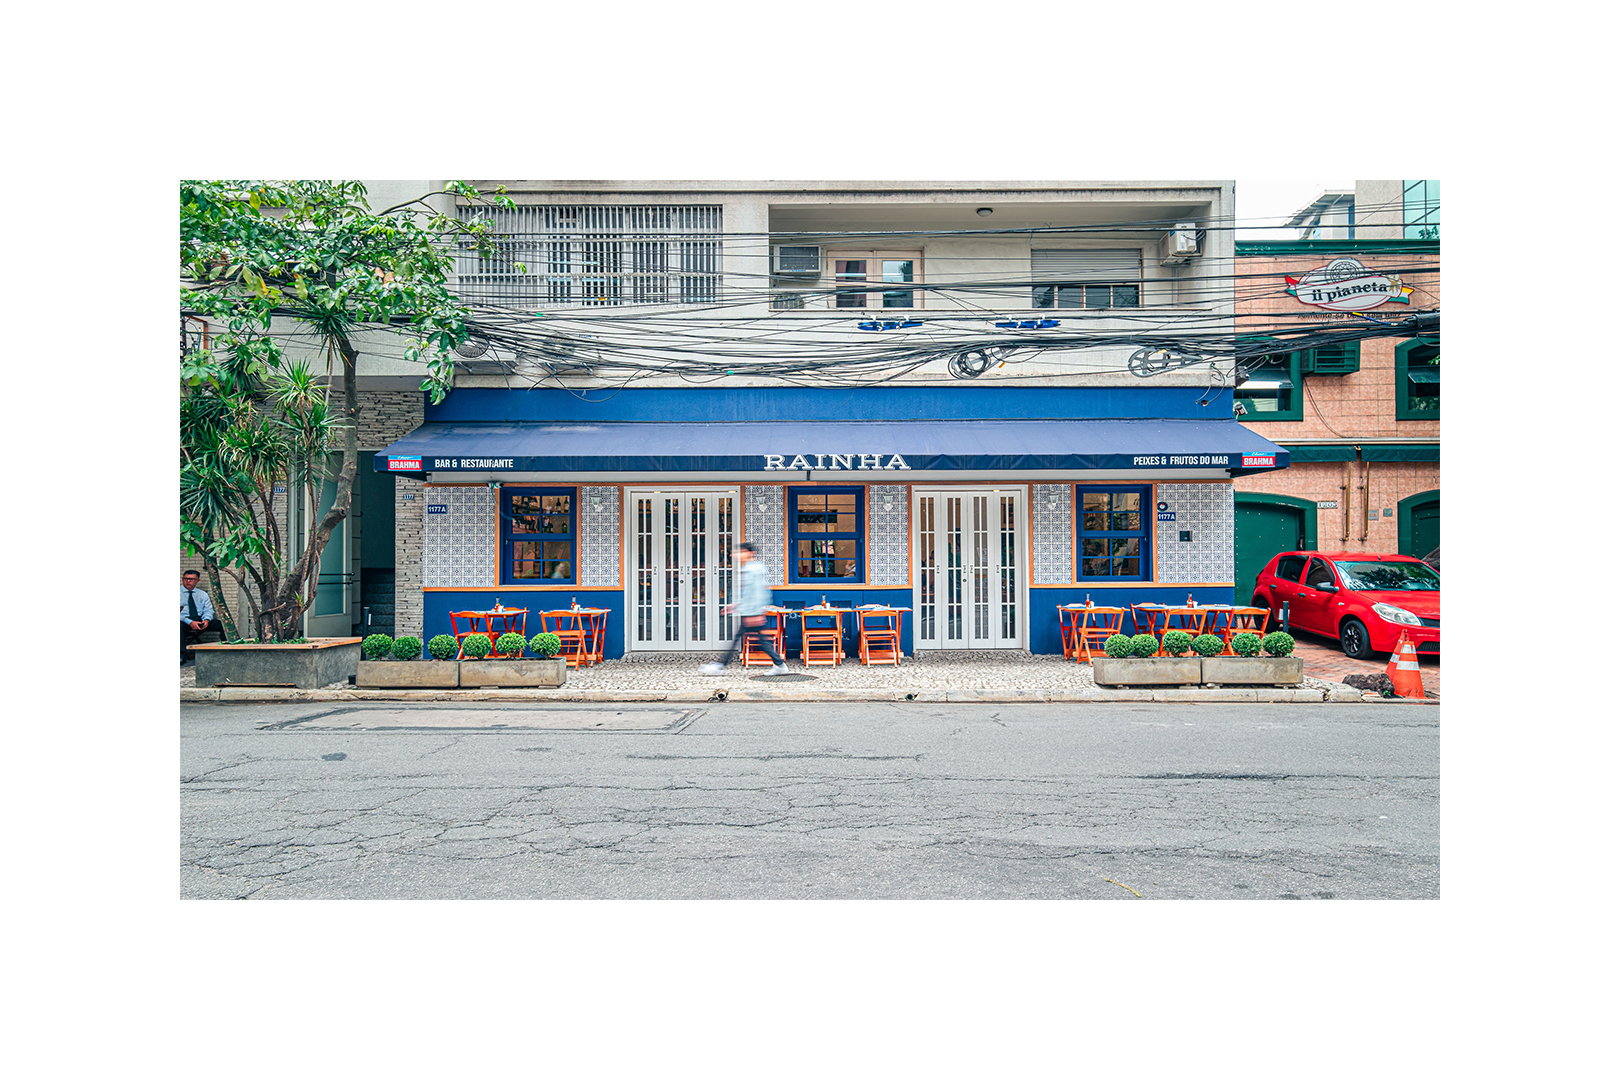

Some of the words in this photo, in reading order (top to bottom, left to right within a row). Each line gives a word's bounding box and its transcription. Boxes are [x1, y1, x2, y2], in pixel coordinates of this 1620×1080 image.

[1312, 289, 1322, 301] il
[1327, 282, 1388, 302] pianeta
[389, 460, 420, 468] BRAHMA
[434, 458, 451, 468] BAR
[451, 458, 458, 468] &
[461, 458, 514, 468] RESTAURANTE
[764, 454, 912, 470] RAINHA
[1133, 456, 1160, 465] PEIXES
[1161, 456, 1167, 465] &
[1169, 455, 1198, 465] FRUTOS
[1199, 455, 1211, 465] DO
[1211, 455, 1229, 465] MAR
[1244, 457, 1274, 466] BRAHMA
